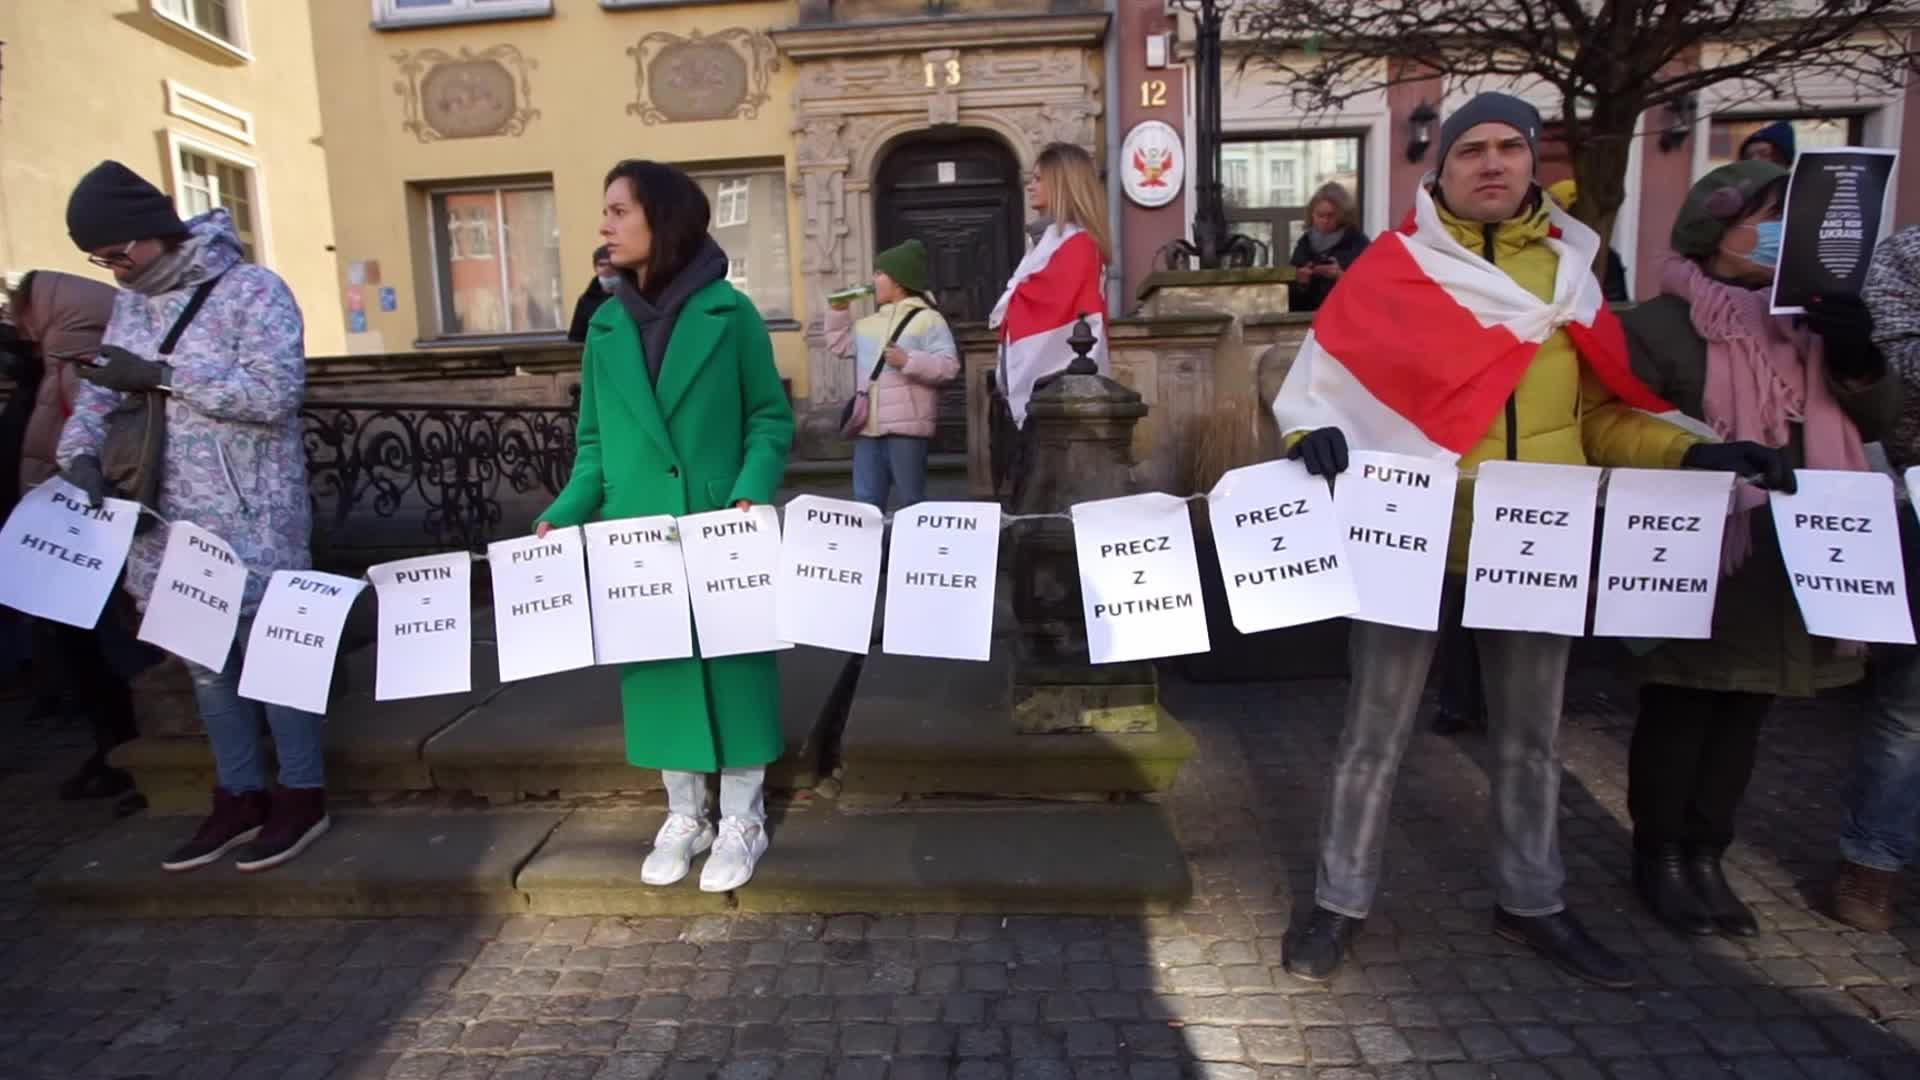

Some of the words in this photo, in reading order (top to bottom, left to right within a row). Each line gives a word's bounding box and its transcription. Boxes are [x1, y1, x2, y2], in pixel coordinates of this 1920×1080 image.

[924, 60, 960, 86] 13
[1140, 80, 1167, 106] 12
[1364, 465, 1430, 488] PUTIN
[51, 492, 115, 523] PUTIN
[1236, 500, 1308, 527] PRECZ
[1496, 507, 1568, 526] PRECZ
[808, 510, 862, 528] PUTIN
[917, 515, 976, 530] PUTIN
[1629, 515, 1700, 531] PRECZ
[1795, 514, 1872, 533] PRECZ
[609, 529, 663, 546] PUTIN
[703, 521, 757, 538] PUTIN
[1350, 526, 1427, 552] HITLER
[21, 531, 102, 570] HITLER
[189, 536, 235, 566] PUTIN
[512, 544, 562, 563] PUTIN
[1101, 536, 1170, 558] PRECZ
[1272, 537, 1286, 551] Z
[1520, 541, 1534, 555] Z
[1653, 548, 1666, 562] Z
[1829, 548, 1843, 562] Z
[395, 567, 450, 584] PUTIN
[797, 564, 862, 584] HITLER
[906, 572, 976, 588] HITLER
[1133, 571, 1145, 584] Z
[1235, 555, 1338, 587] PUTINEM
[1476, 568, 1577, 588] PUTINEM
[288, 577, 342, 597] PUTIN
[608, 583, 672, 599] HITLER
[707, 574, 770, 592] HITLER
[1608, 577, 1707, 592] PUTINEM
[1794, 573, 1896, 596] PUTINEM
[172, 580, 228, 613] HITLER
[512, 594, 572, 616] HITLER
[1094, 594, 1192, 618] PUTINEM
[395, 618, 455, 635] HITLER
[267, 626, 324, 648] HITLER
